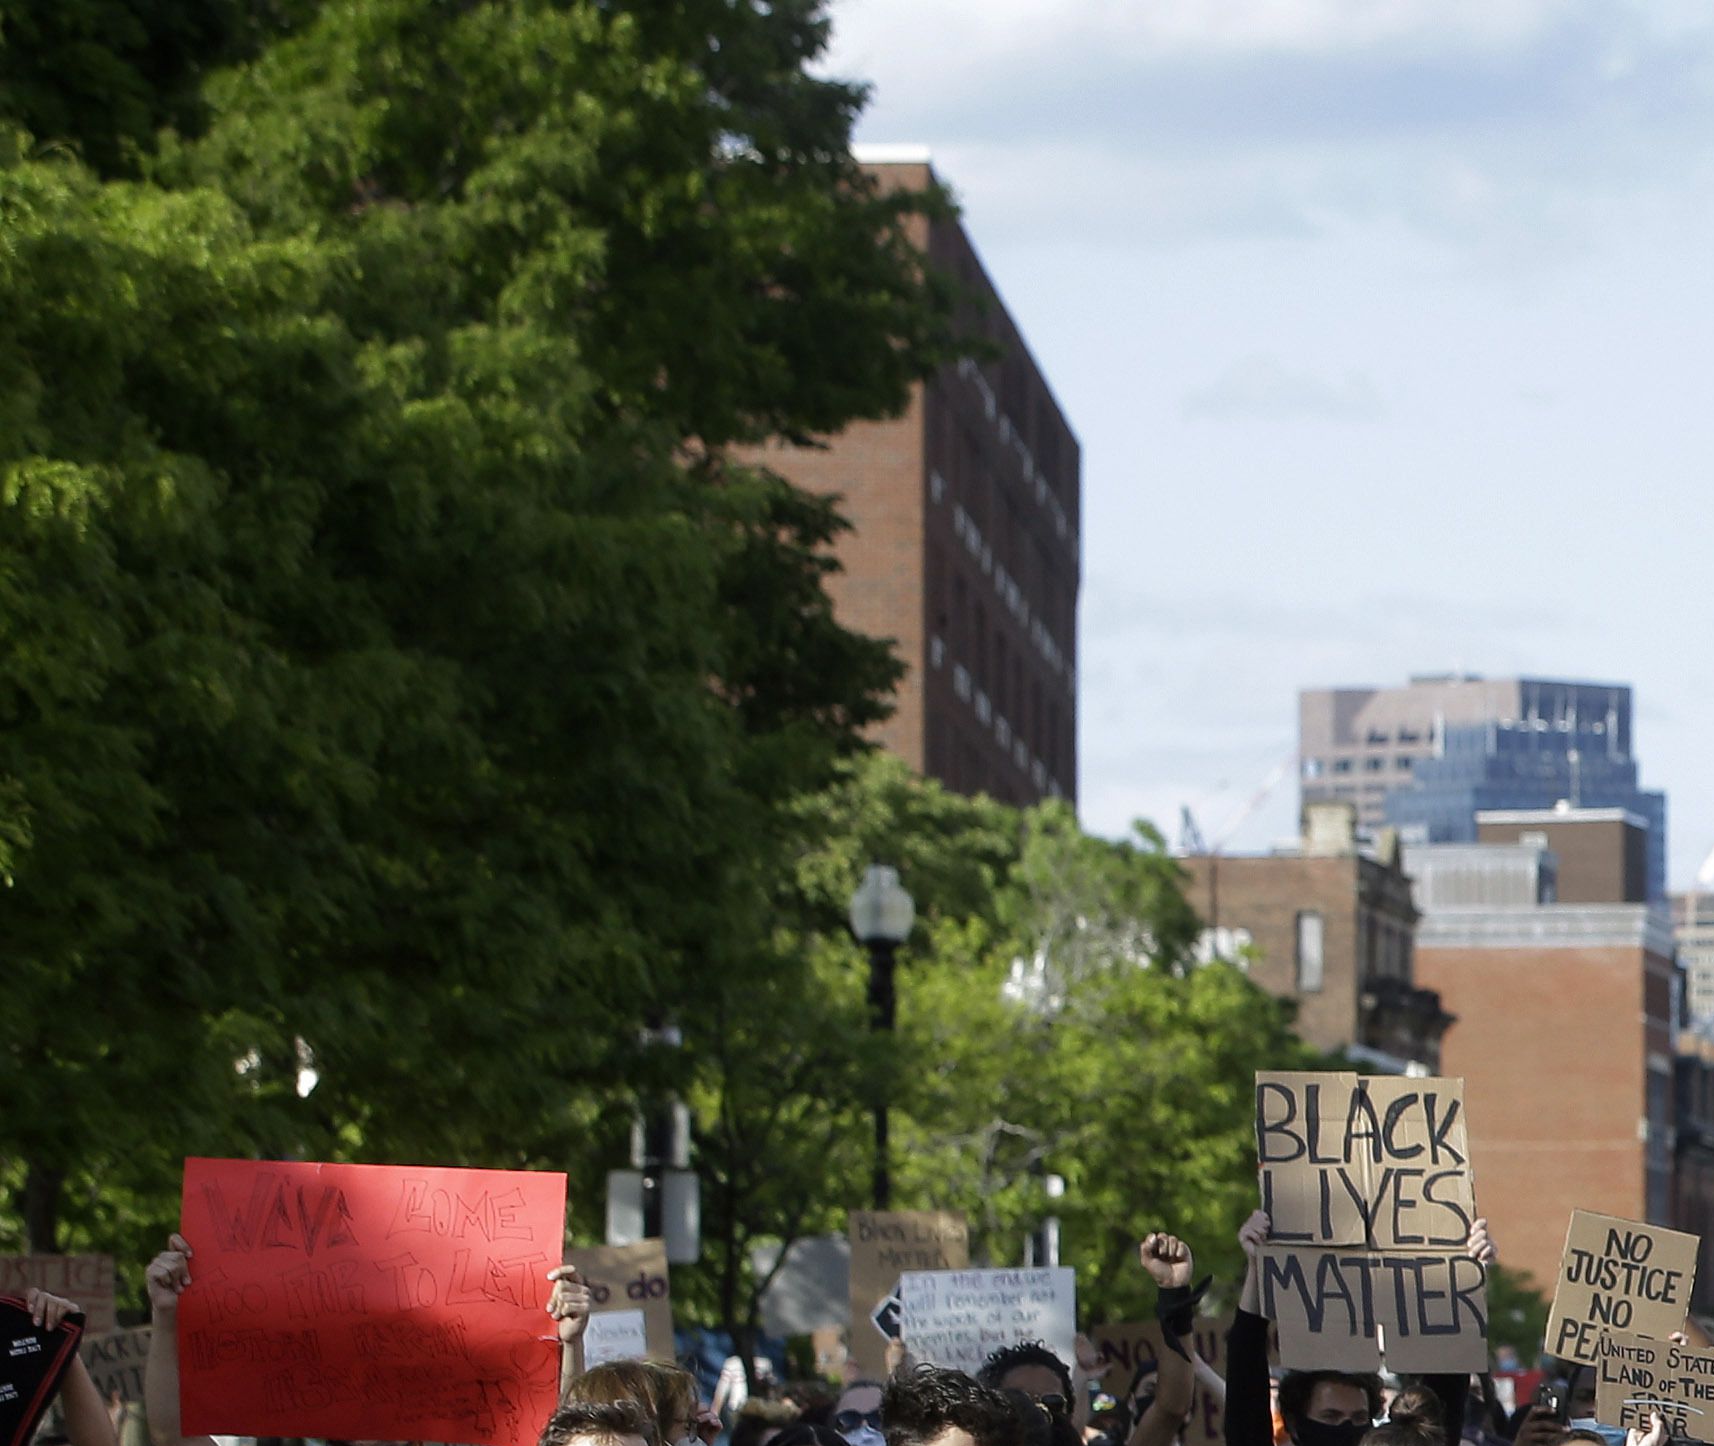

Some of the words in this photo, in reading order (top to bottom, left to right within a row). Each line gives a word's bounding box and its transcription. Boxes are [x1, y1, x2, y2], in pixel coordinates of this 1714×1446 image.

[1256, 1080, 1466, 1164] BLACK
[1264, 1168, 1472, 1249] LIVES
[1604, 1228, 1653, 1263] NO
[627, 1270, 666, 1300] do
[1567, 1248, 1682, 1304] JUSTICE
[1263, 1254, 1488, 1338] MATTER
[1589, 1293, 1632, 1328] NO
[1601, 1336, 1655, 1364] UNITED
[1602, 1359, 1654, 1389] LAND
